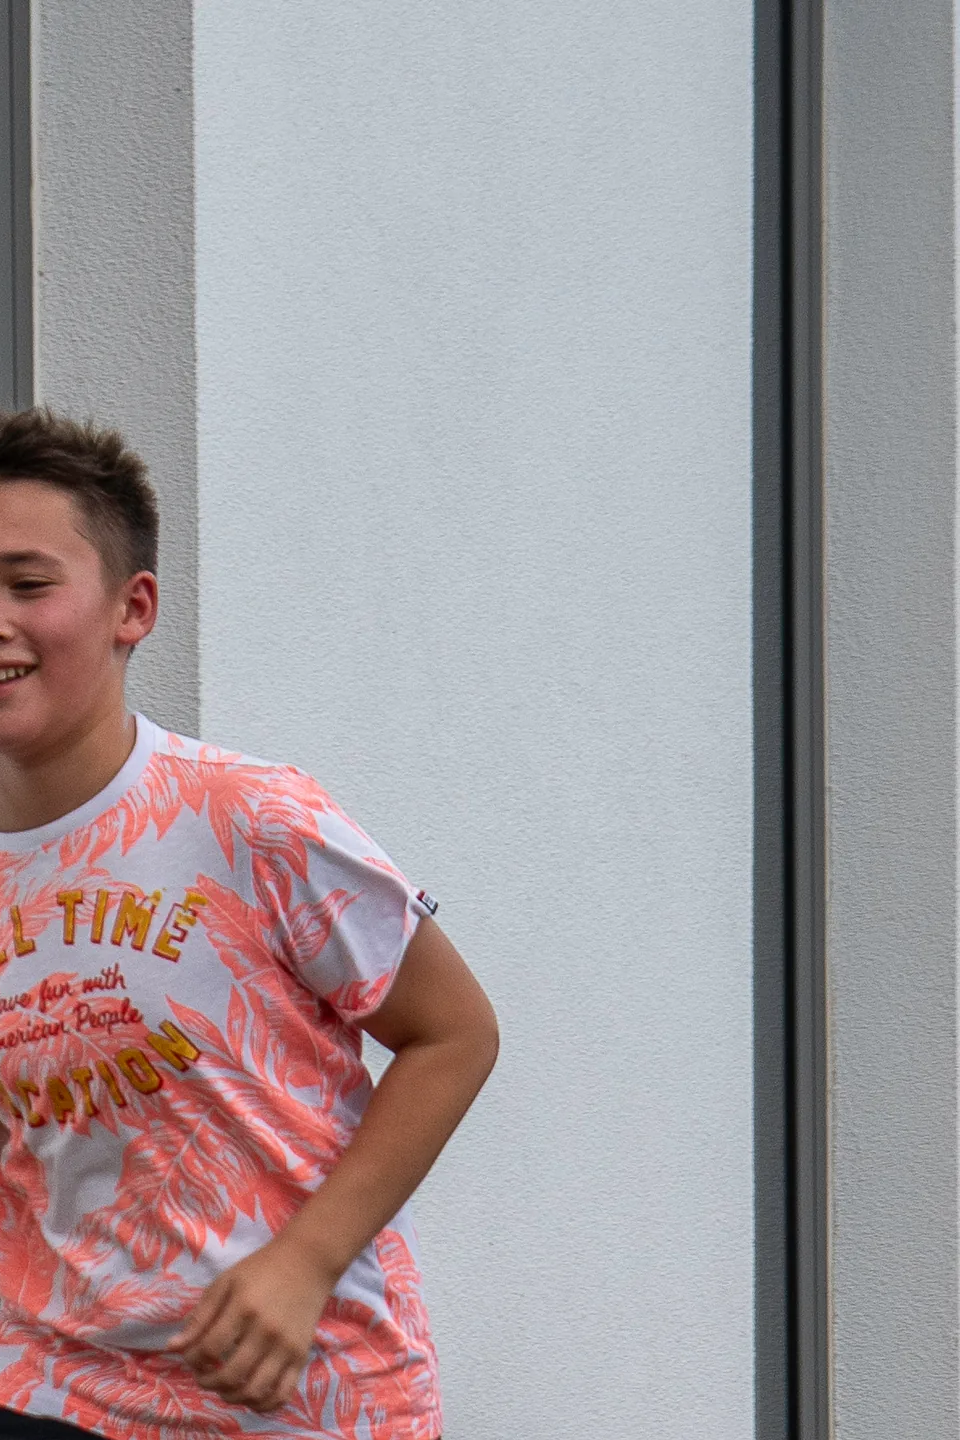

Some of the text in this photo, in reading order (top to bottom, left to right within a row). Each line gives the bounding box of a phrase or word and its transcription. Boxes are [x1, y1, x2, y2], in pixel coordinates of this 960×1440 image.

[56, 888, 208, 963] TIME
[38, 978, 75, 1013] fun
[82, 962, 127, 994] with
[73, 997, 144, 1035] People
